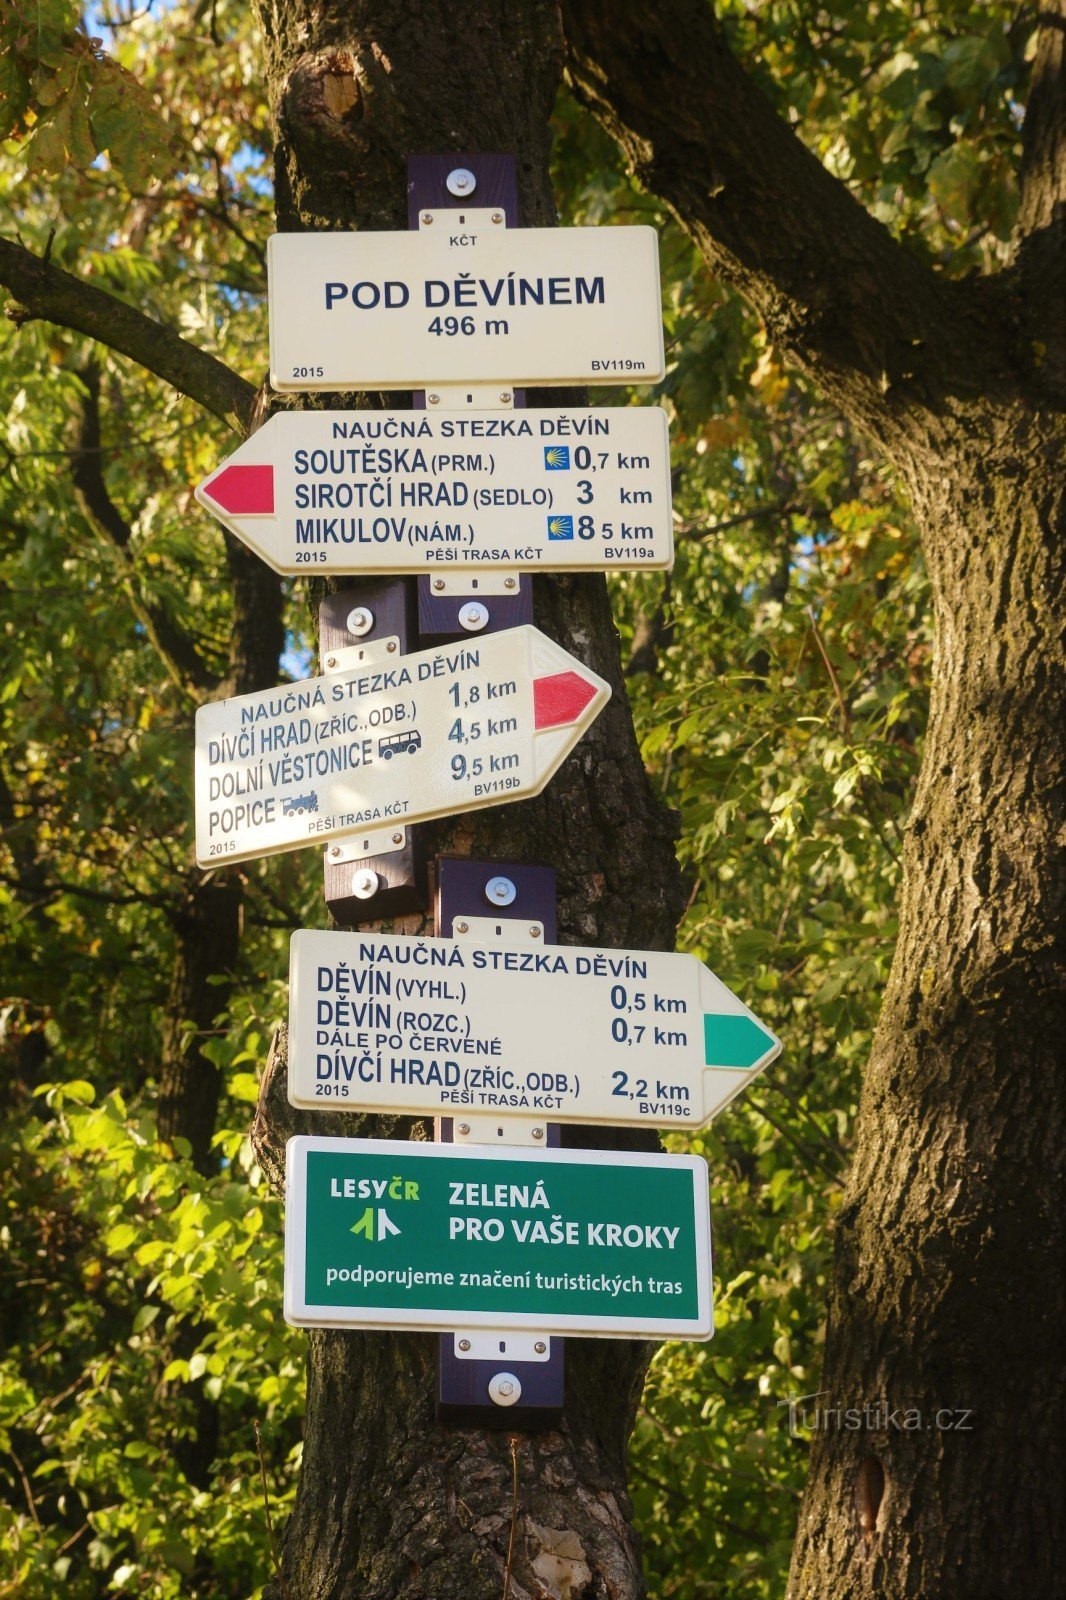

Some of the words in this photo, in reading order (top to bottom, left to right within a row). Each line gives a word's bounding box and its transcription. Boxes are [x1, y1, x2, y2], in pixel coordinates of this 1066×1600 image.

[449, 234, 478, 246] KČT
[325, 281, 410, 310] POD
[425, 272, 605, 308] DĚVÍNEM
[428, 316, 476, 336] 496
[485, 318, 509, 334] m
[292, 367, 324, 378] 2015
[591, 359, 645, 371] BV119m
[333, 419, 432, 439] NAUČNÁ
[440, 419, 534, 437] STEZKA
[540, 417, 609, 436] DĚVÍN
[574, 445, 609, 472] 0,7
[618, 452, 650, 470] km
[295, 478, 395, 509] SIROTČÍ
[401, 482, 468, 507] HRAD
[576, 480, 593, 505] 3
[620, 487, 652, 504] km
[621, 522, 654, 539] km
[295, 551, 327, 563] 2015
[426, 547, 457, 561] PĚŠÍ
[461, 549, 511, 560] TRASA
[514, 547, 543, 559] KČT
[605, 547, 654, 559] BV119a
[242, 685, 325, 725] NAUČNÁ
[332, 670, 412, 701] STEZKA
[418, 649, 480, 682] DĚVÍN
[448, 682, 480, 709] 1,8
[487, 679, 516, 698] km
[209, 723, 255, 765] DÍVČÍ
[261, 718, 311, 753] HRAD
[448, 718, 481, 745] 4,5
[488, 716, 517, 736] km
[209, 765, 264, 802] DOLNÍ
[269, 738, 373, 787] VĚSTONICE
[451, 754, 483, 782] 9,5
[489, 752, 520, 771] km
[474, 777, 521, 796] BV119b
[209, 797, 275, 836] POPICE
[308, 816, 335, 834] PĚŠÍ
[339, 808, 381, 827] TRASA
[384, 800, 409, 819] KČT
[210, 840, 236, 855] 2015
[359, 942, 465, 967] NAUČNÁ
[472, 950, 569, 973] STEZKA
[576, 955, 647, 979] DĚVÍN
[317, 962, 390, 996] DĚVÍN
[317, 994, 391, 1029] DĚVÍN
[611, 984, 646, 1012] 0,5
[654, 995, 687, 1013] km
[317, 1029, 369, 1048] DÁLE
[376, 1034, 403, 1051] PO
[409, 1033, 502, 1055] ČERVENÉ
[611, 1017, 646, 1044] 0,7
[654, 1027, 687, 1045] km
[317, 1050, 382, 1083] DÍVČÍ
[390, 1057, 460, 1087] HRAD
[316, 1084, 349, 1097] 2015
[440, 1088, 475, 1104] PĚŠÍ
[479, 1093, 530, 1107] TRASA
[533, 1092, 563, 1109] KČT
[611, 1070, 648, 1098] 2,2
[655, 1081, 689, 1100] km
[639, 1102, 691, 1116] BV119c
[449, 1180, 550, 1209] ZELENÁ
[449, 1218, 504, 1242] PRO
[511, 1215, 580, 1245] VAŠE
[588, 1224, 680, 1249] KROKY
[326, 1265, 454, 1289] podporujeme
[460, 1271, 530, 1289] značení
[536, 1272, 643, 1296] turistických
[648, 1277, 682, 1295] tras
